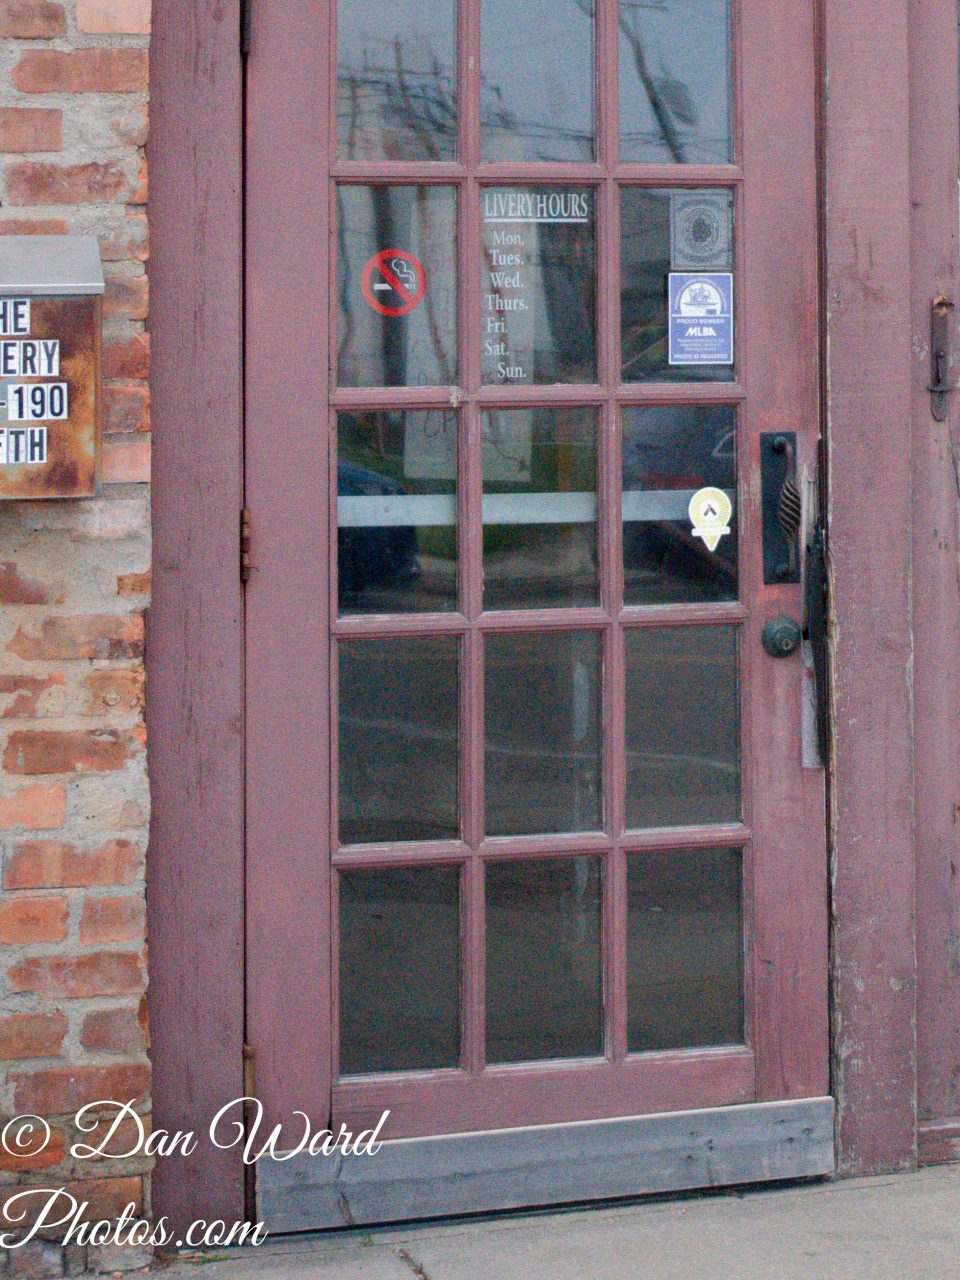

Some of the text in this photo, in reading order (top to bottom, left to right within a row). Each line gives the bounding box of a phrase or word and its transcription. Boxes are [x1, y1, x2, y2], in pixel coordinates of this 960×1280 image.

[484, 192, 589, 218] LIVERY HOURS
[492, 230, 525, 246] Mon.
[489, 249, 525, 266] Tues.
[489, 271, 525, 288] Wed.
[485, 294, 529, 311] Thurs.
[486, 316, 509, 333] Fri.
[685, 326, 717, 337] MLBA
[484, 339, 510, 356] Sat.
[497, 362, 527, 378] Sun.
